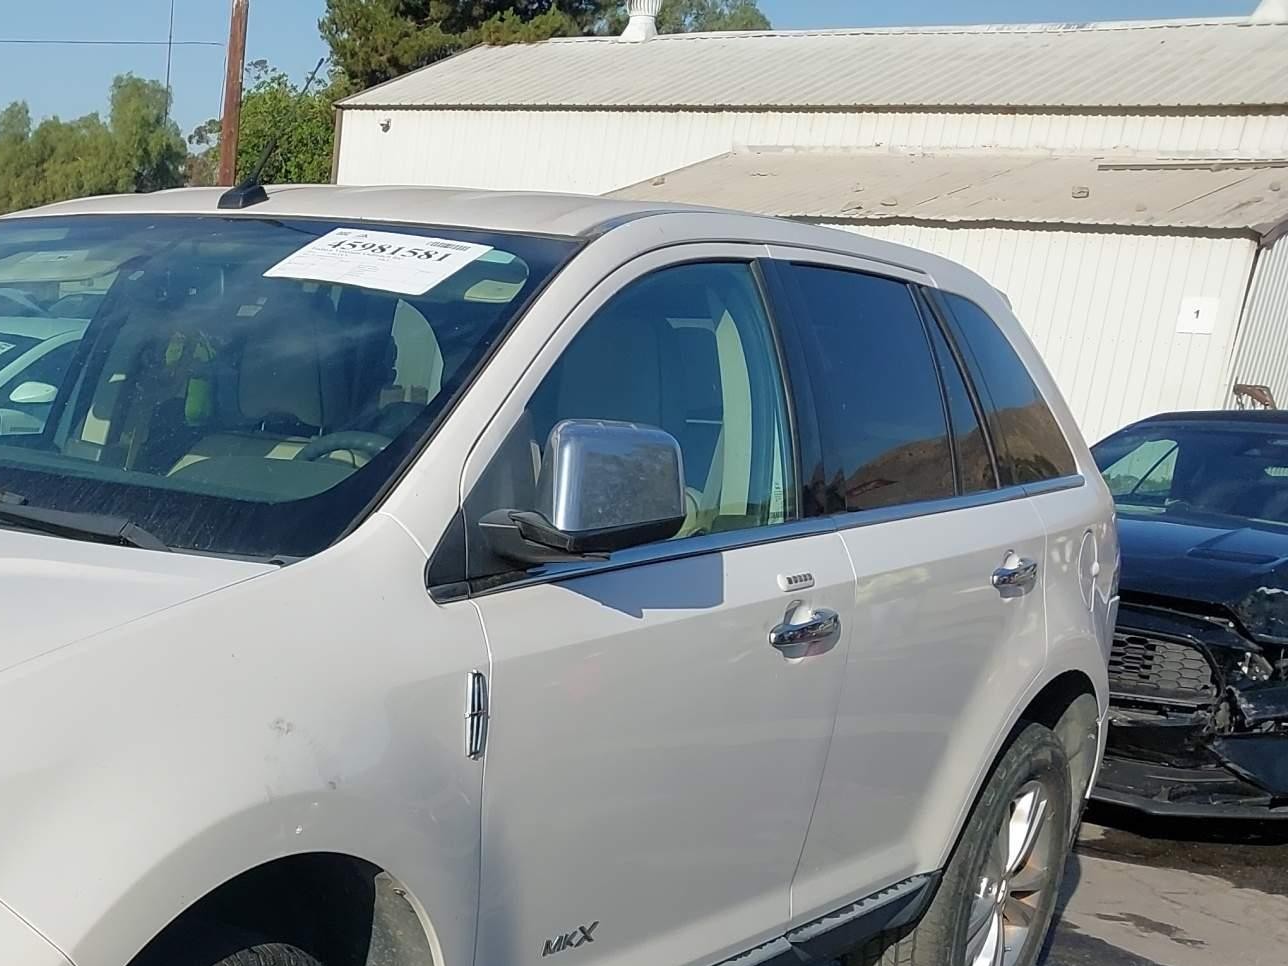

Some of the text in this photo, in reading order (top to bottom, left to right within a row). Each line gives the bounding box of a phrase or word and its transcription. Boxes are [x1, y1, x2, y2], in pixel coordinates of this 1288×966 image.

[328, 240, 452, 262] 45981581
[1193, 309, 1201, 320] 1
[542, 920, 600, 957] MKX
